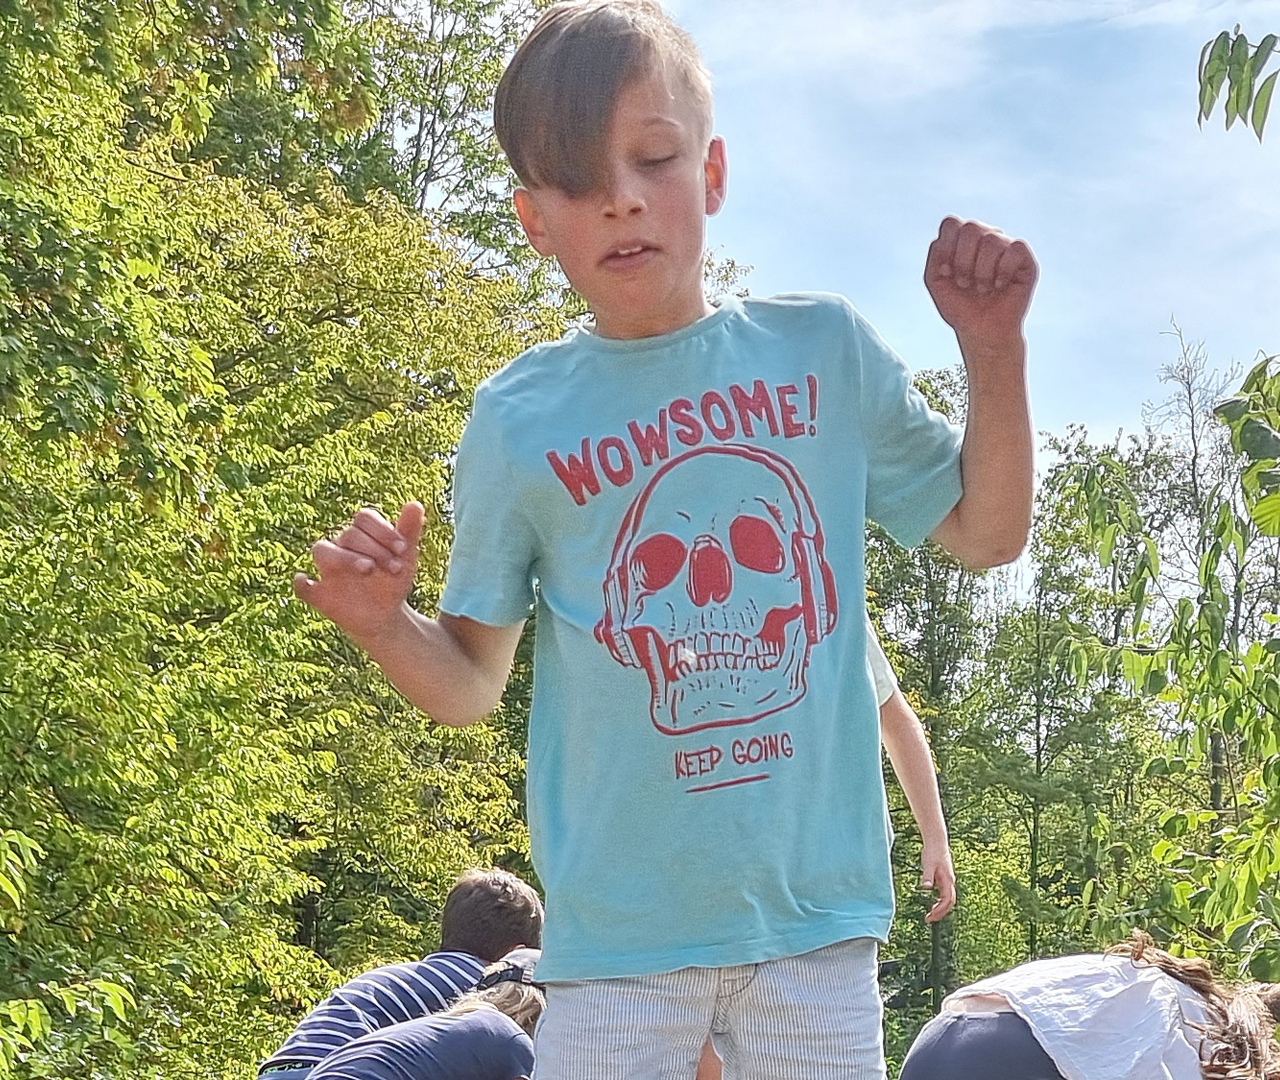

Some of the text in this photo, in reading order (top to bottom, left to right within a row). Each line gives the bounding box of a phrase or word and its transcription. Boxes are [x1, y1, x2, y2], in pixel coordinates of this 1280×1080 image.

[546, 374, 817, 506] WOWSOME!
[675, 732, 794, 779] KEEP GOING
